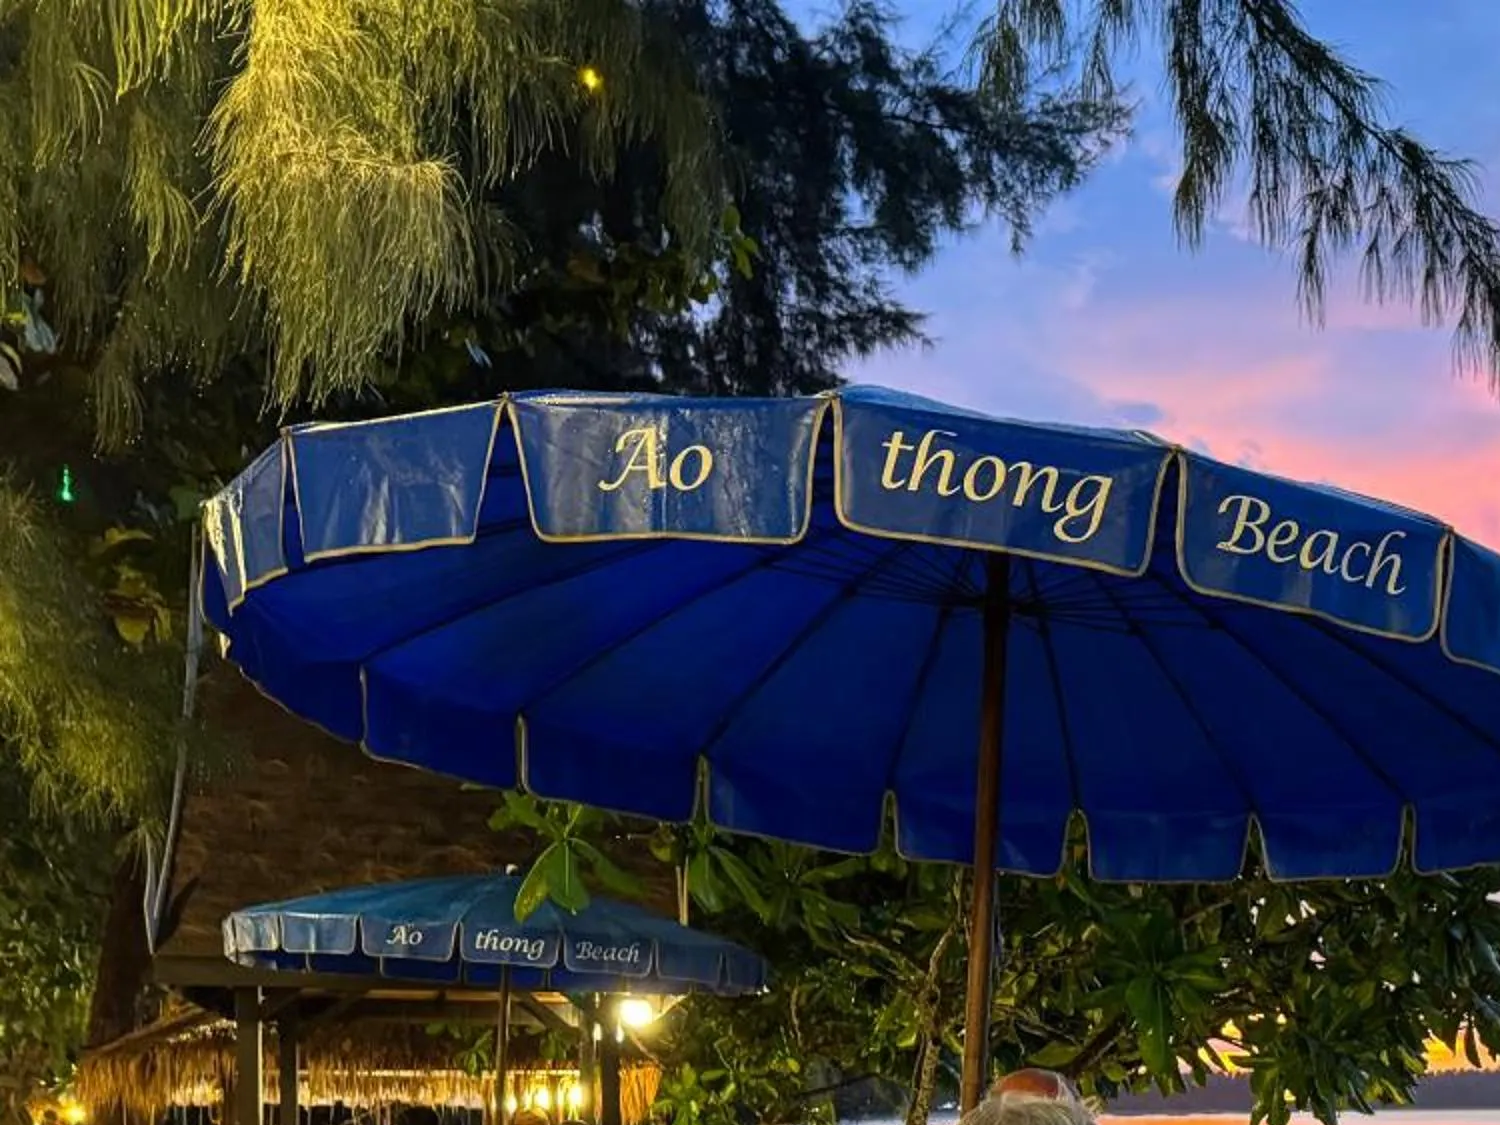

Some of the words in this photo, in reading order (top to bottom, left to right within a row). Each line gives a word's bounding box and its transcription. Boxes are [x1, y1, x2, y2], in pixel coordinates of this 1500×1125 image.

[598, 425, 714, 492] Ao
[880, 429, 1113, 543] thong
[1217, 495, 1407, 595] Beach
[387, 924, 423, 946] Ao
[475, 929, 545, 960] thong
[576, 941, 640, 964] Beach
